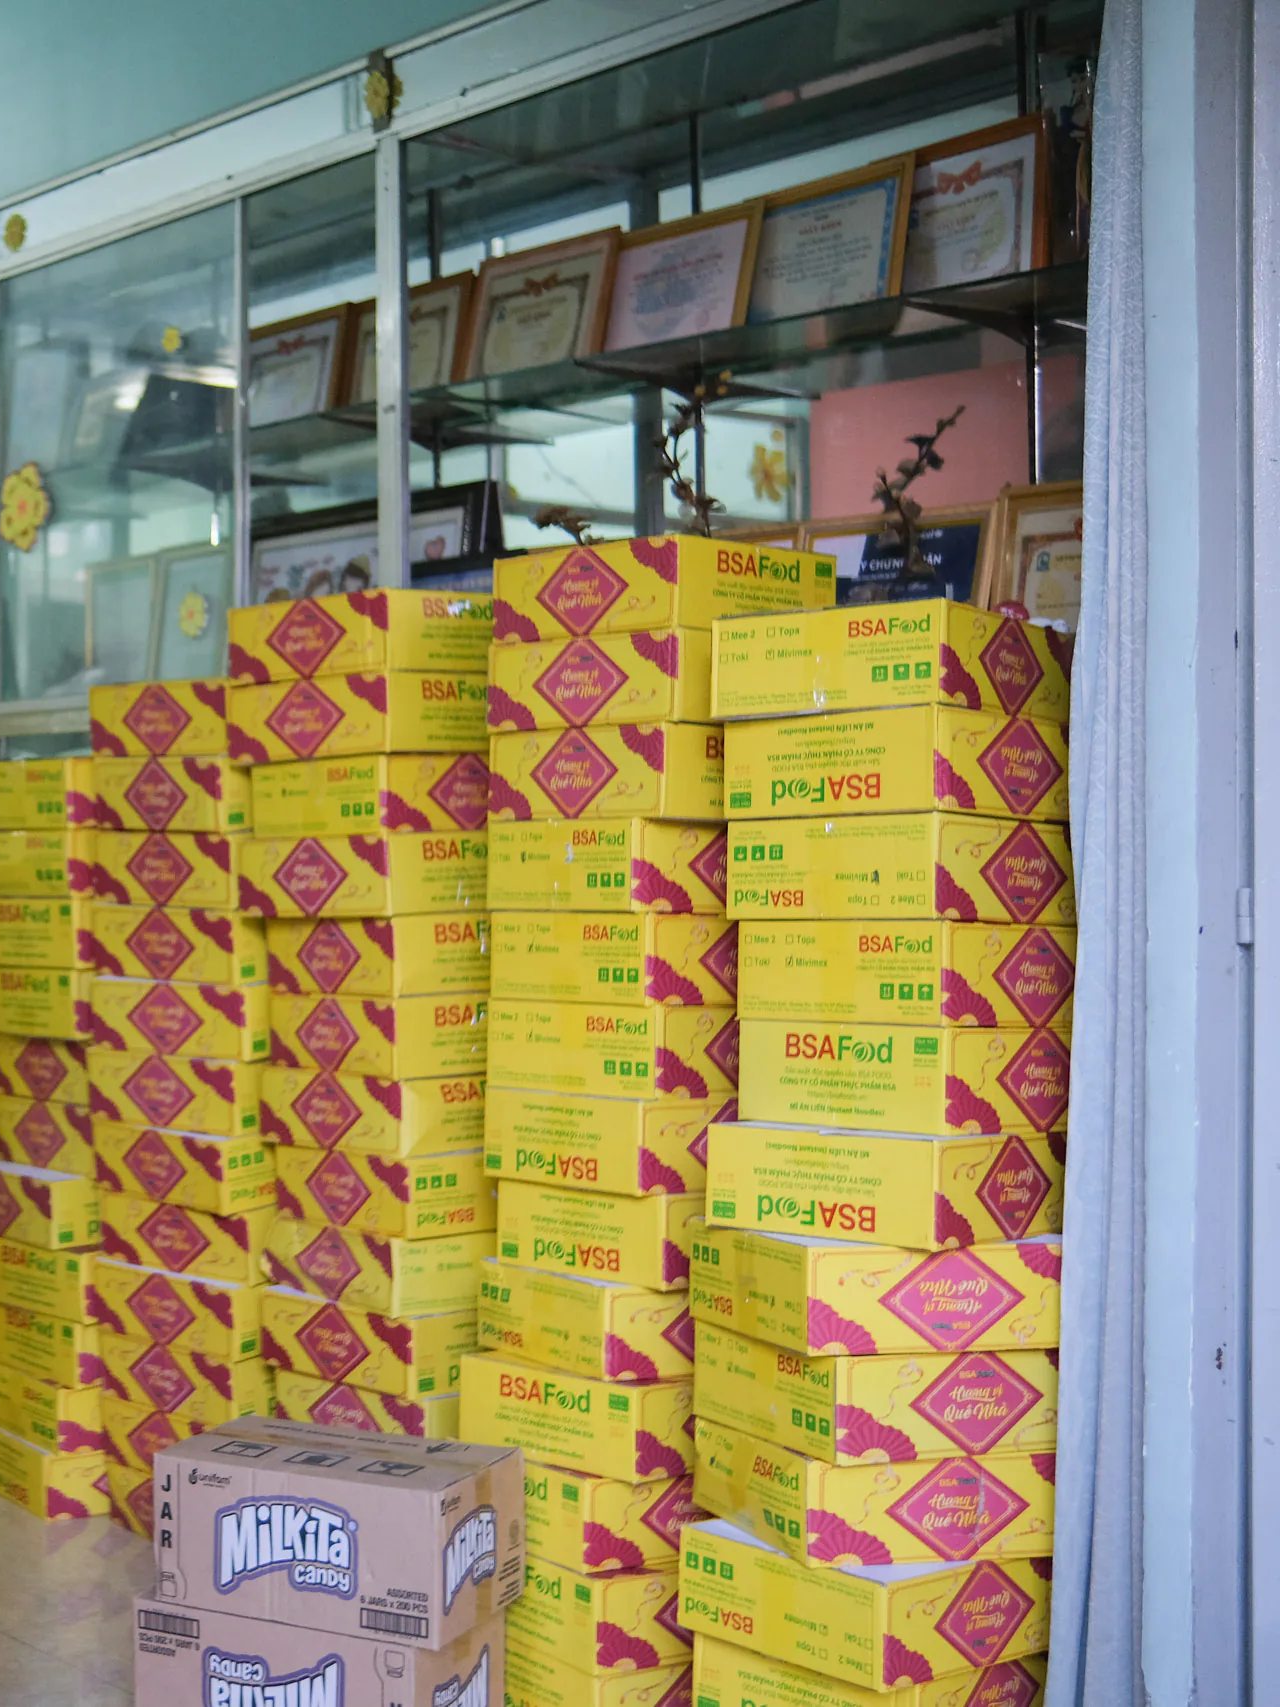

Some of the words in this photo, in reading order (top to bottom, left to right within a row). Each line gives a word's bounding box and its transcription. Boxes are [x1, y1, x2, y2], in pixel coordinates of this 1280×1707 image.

[785, 1034, 893, 1063] BSAFood
[757, 1195, 876, 1233] BSAFood
[949, 1385, 991, 1402] Hương
[944, 1403, 975, 1424] Quê
[975, 1401, 1008, 1420] Nhà
